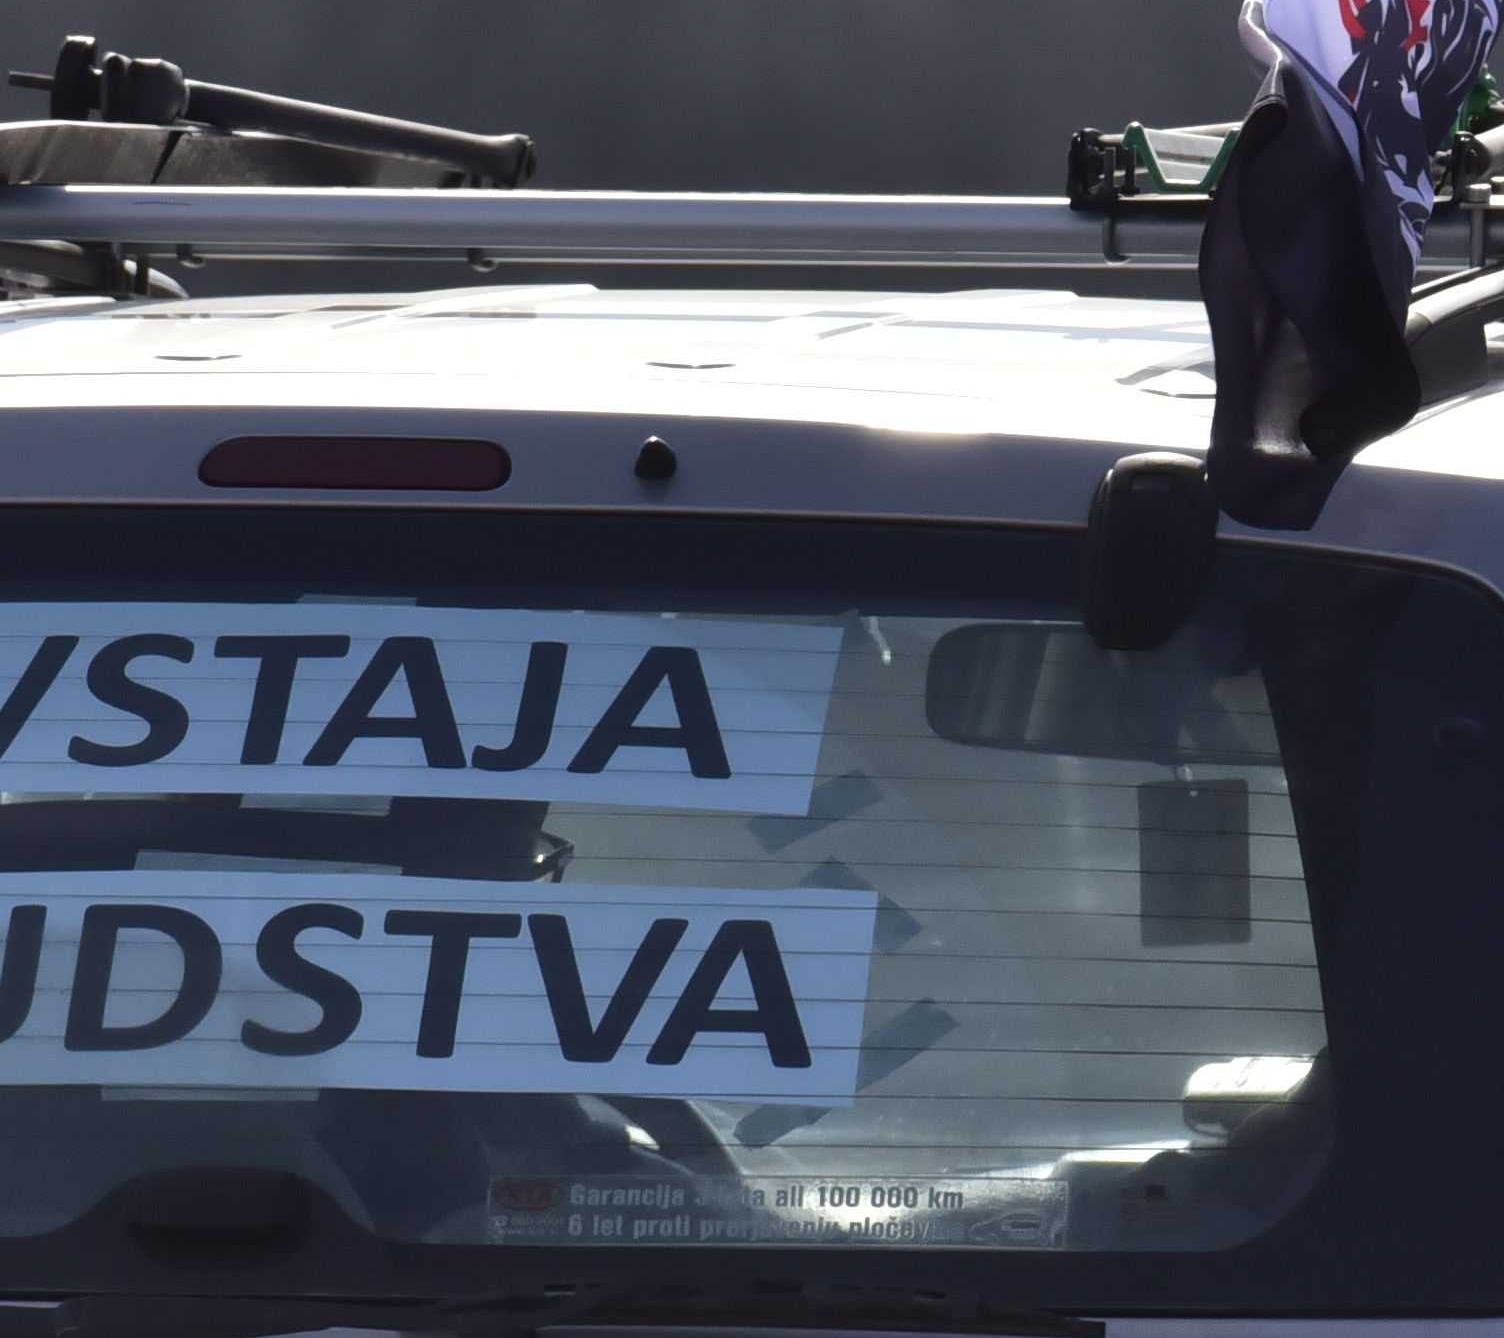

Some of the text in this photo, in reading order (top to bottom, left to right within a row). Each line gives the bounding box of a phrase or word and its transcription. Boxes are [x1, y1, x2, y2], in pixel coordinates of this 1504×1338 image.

[570, 1183, 685, 1209] Garancija
[718, 1184, 765, 1207] ta
[818, 1185, 860, 1208] 100
[871, 1185, 918, 1208] 000
[928, 1186, 964, 1209] km
[567, 1213, 584, 1237] 6
[592, 1214, 624, 1237] let
[633, 1215, 691, 1240] proti
[849, 1216, 965, 1241] pločeve
